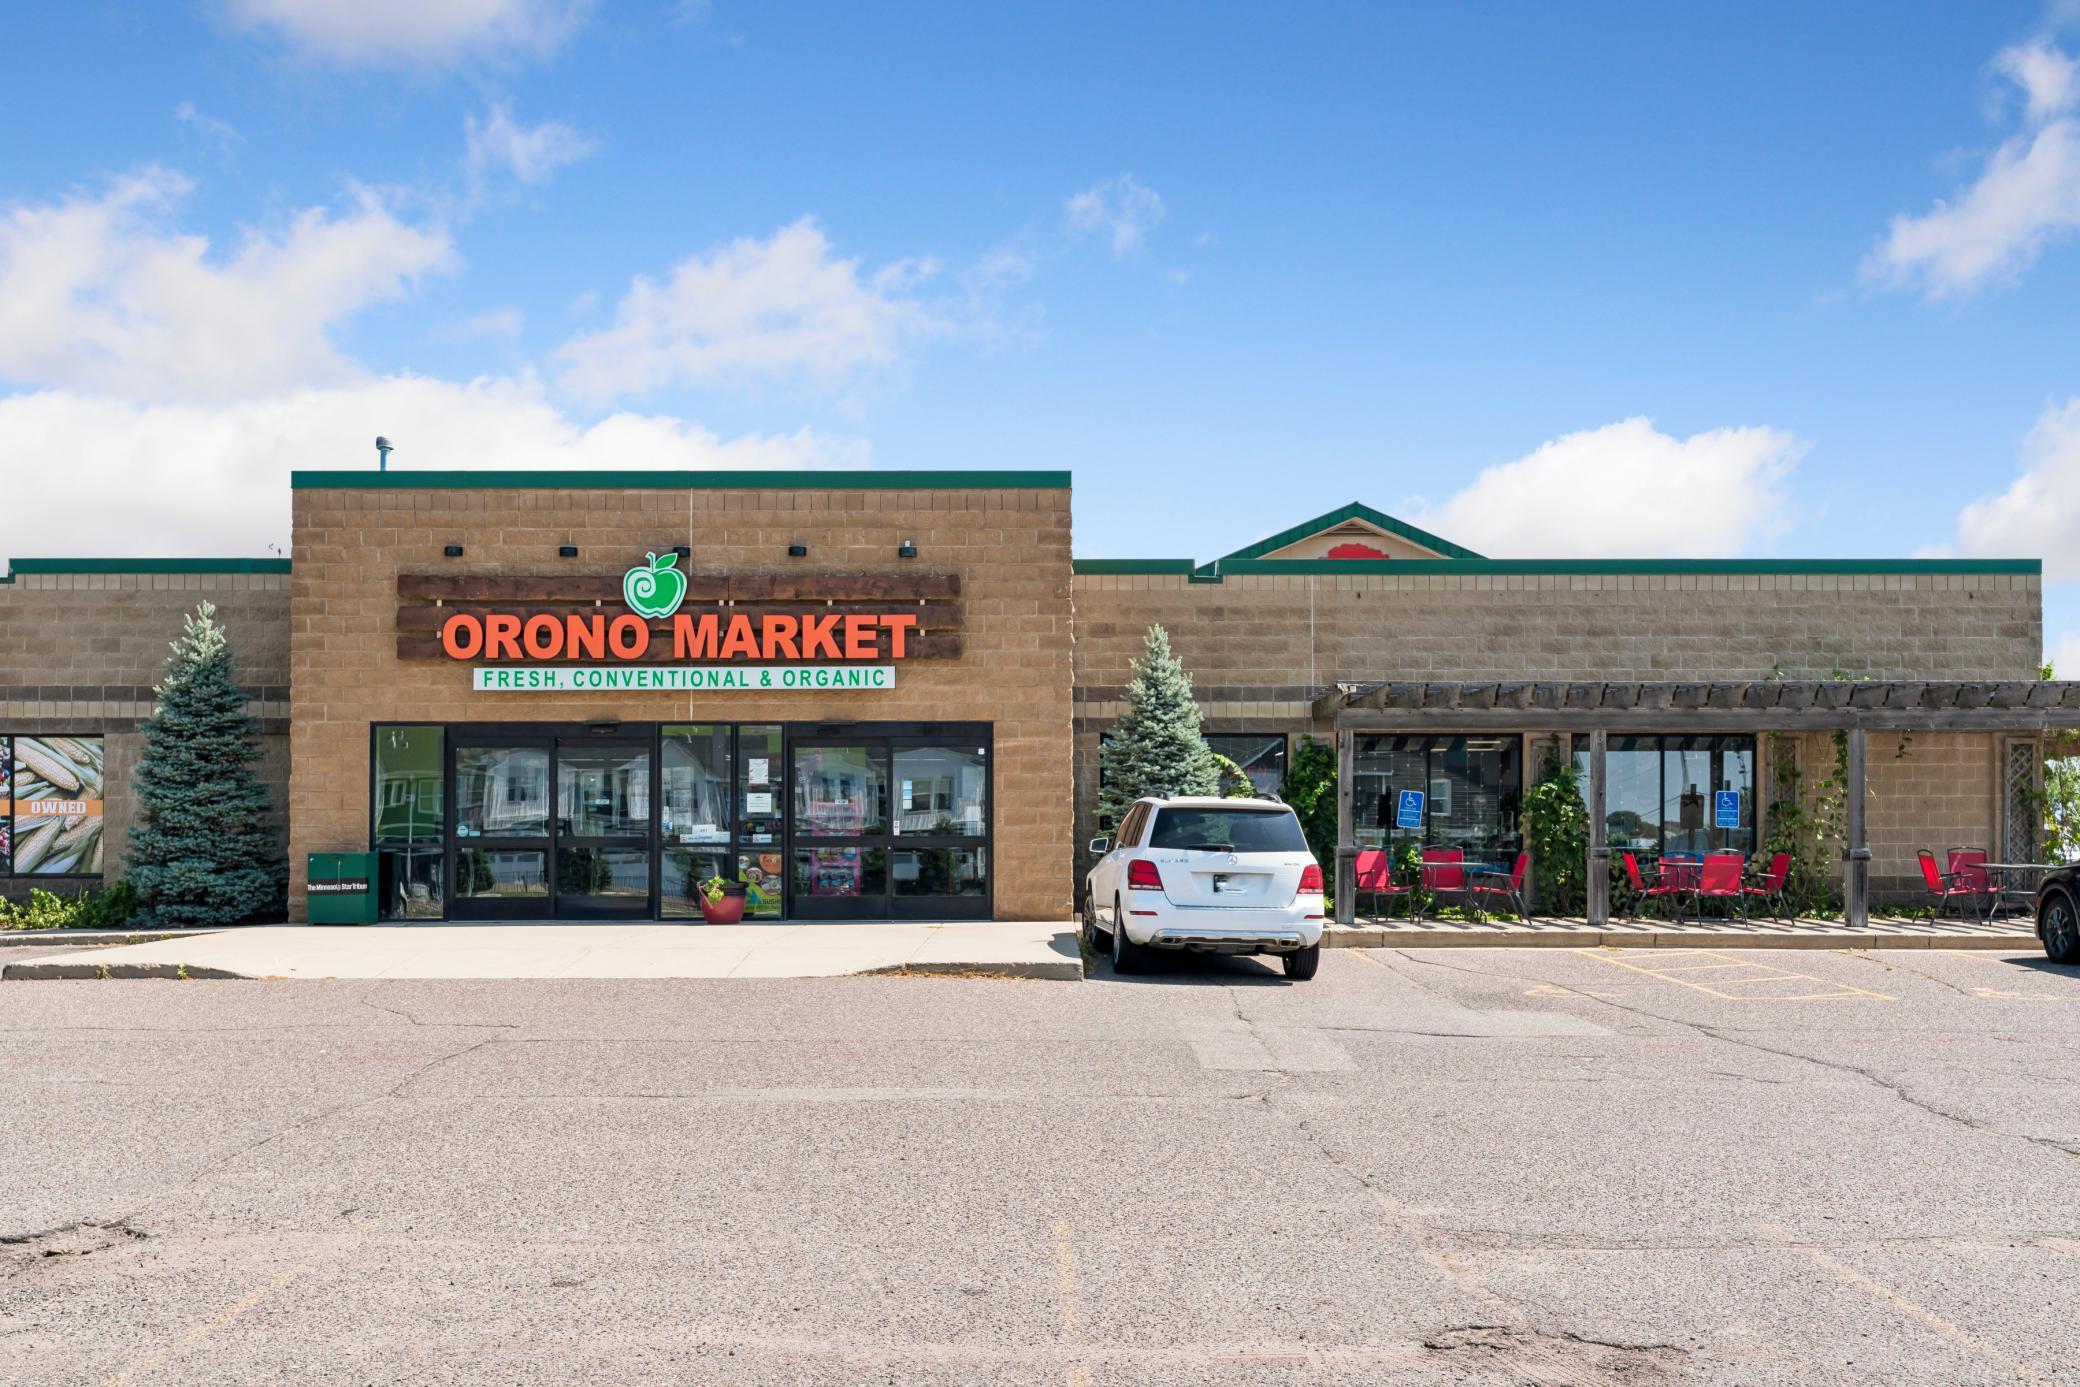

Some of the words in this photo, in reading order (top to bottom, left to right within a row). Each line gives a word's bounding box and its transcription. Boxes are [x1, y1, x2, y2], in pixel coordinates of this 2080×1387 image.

[442, 614, 649, 659] ORONO
[674, 614, 917, 659] MARKET
[483, 669, 564, 689] FRESH,
[572, 669, 752, 689] CONVENTIONAL
[759, 668, 774, 689] &
[781, 668, 886, 688] ORGANIC
[31, 801, 87, 814] OWNED
